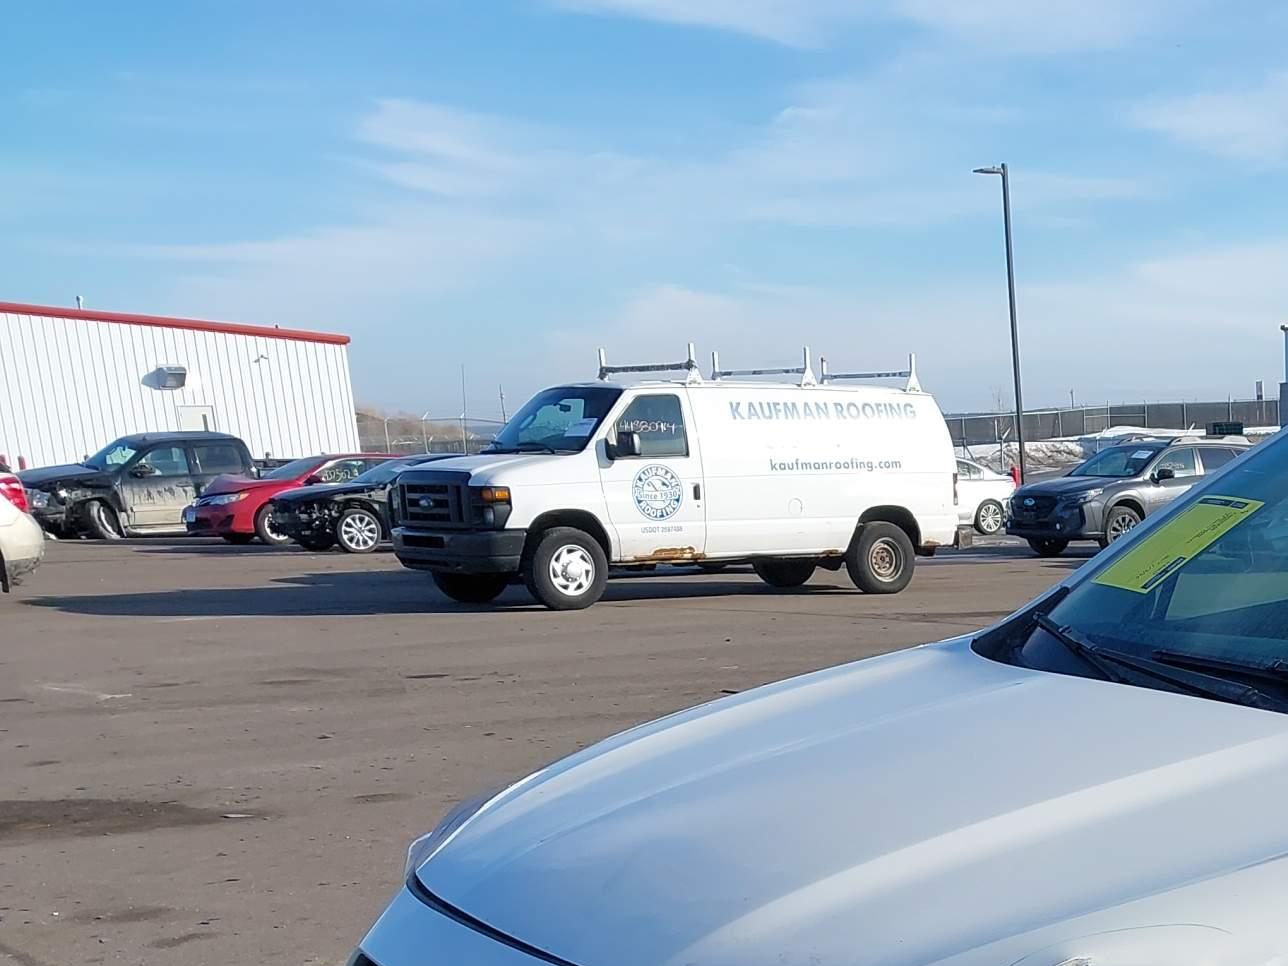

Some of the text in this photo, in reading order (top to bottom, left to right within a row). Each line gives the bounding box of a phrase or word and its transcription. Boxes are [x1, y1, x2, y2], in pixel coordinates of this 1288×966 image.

[728, 401, 917, 421] KAUFMAN ROOFING
[769, 457, 902, 473] kaufmanroofing.com
[635, 465, 681, 488] KAUFMAN
[638, 488, 678, 499] Since 1930
[638, 499, 679, 518] ROOFING
